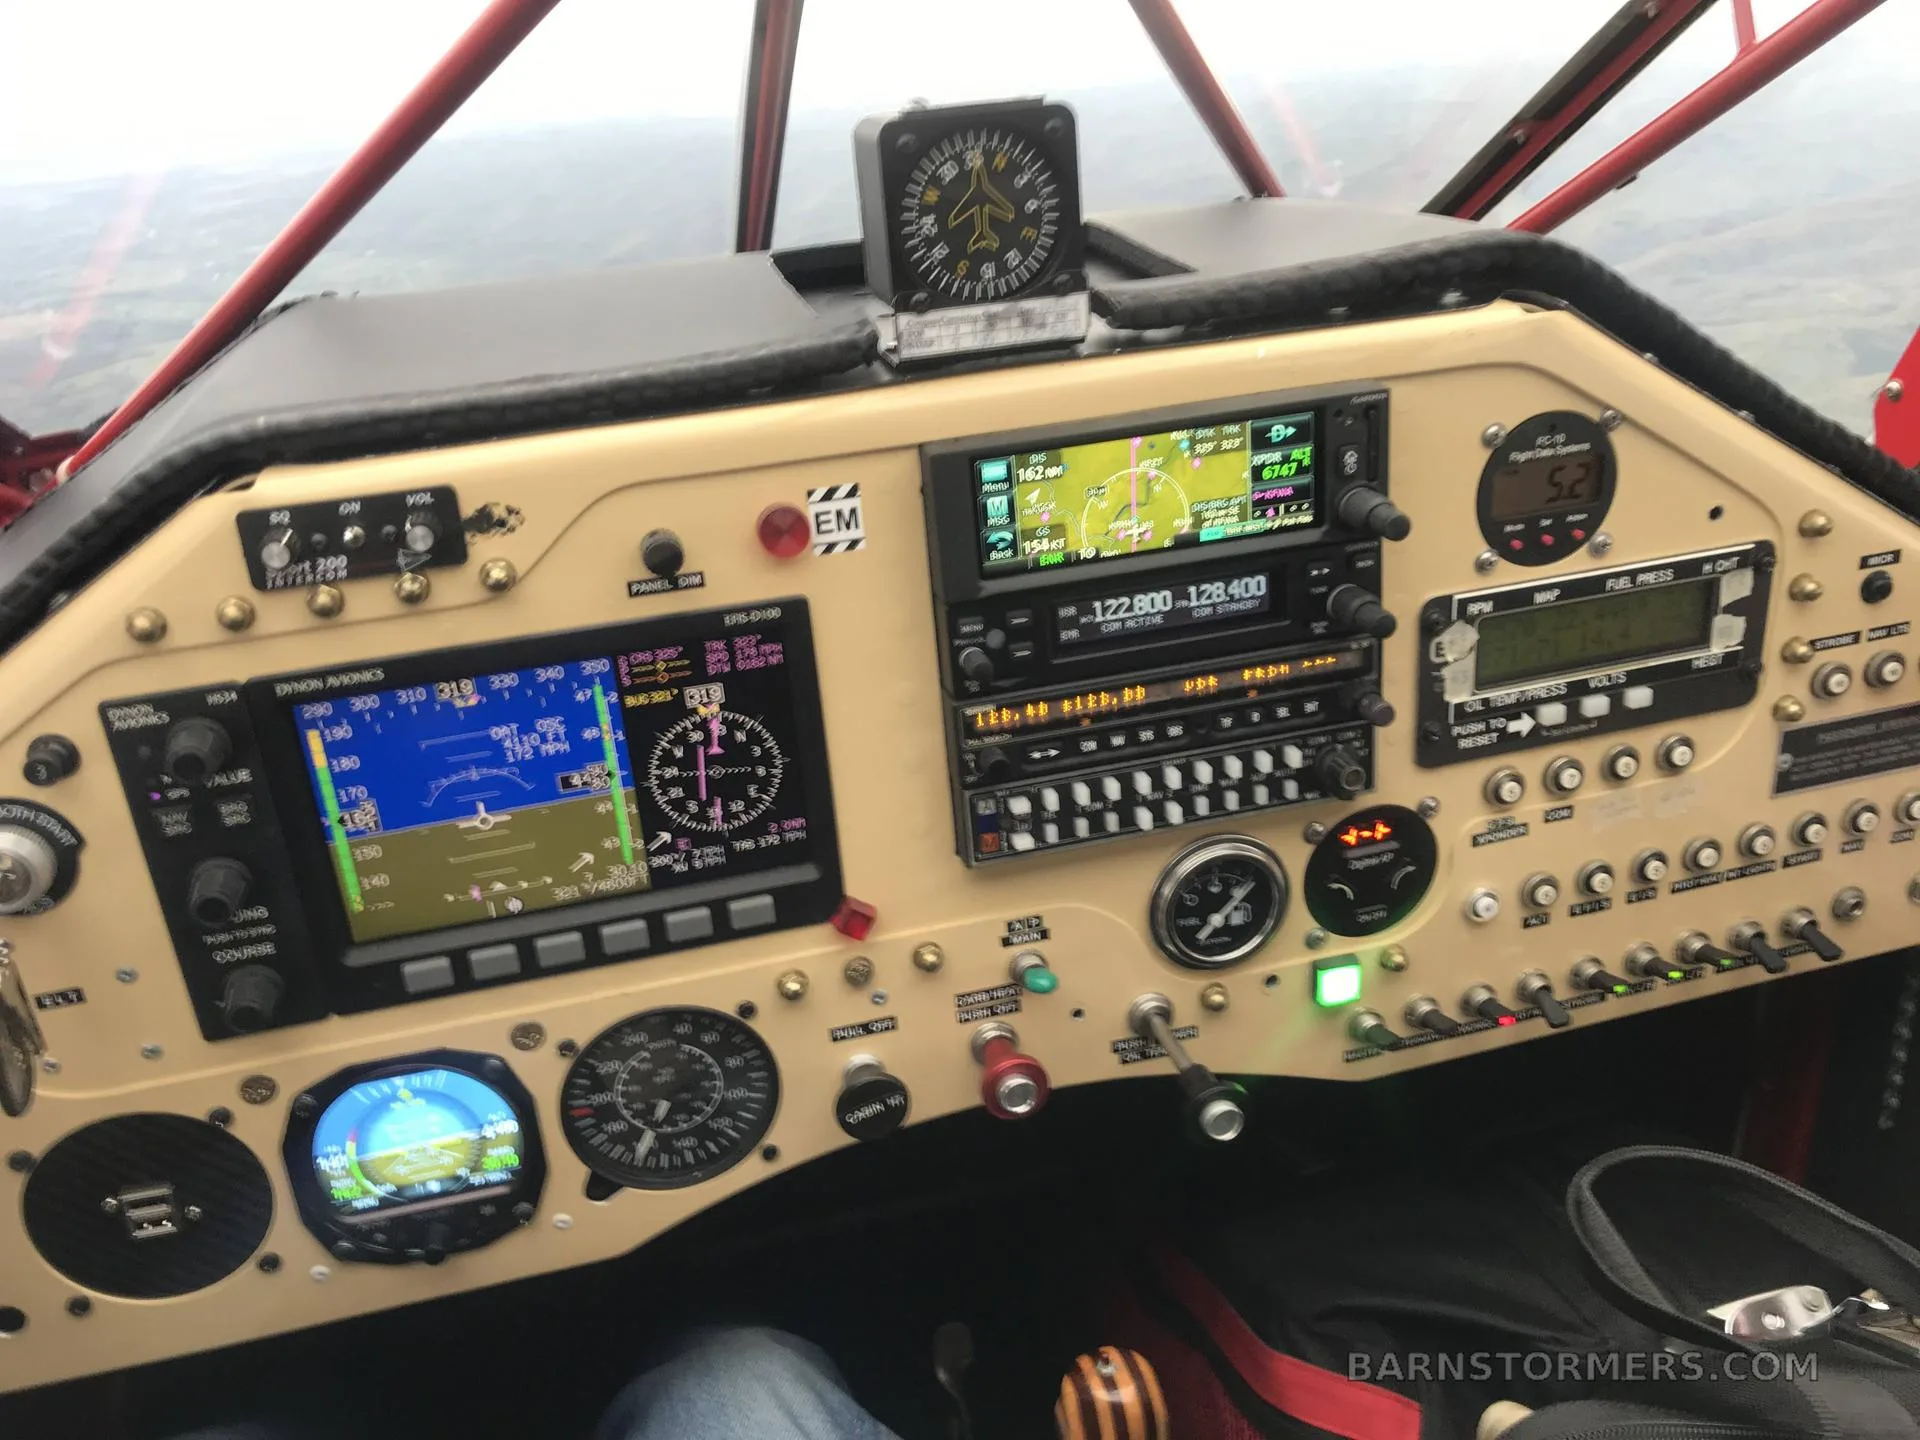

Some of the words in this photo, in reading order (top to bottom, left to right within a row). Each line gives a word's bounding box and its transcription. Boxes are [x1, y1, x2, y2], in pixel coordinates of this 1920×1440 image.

[815, 506, 860, 535] EM
[631, 579, 674, 596] PANEL
[677, 573, 703, 588] DIM
[1187, 574, 1268, 608] 128.400
[1092, 589, 1174, 623] 122.800
[1587, 671, 1628, 689] VOLTS
[1450, 720, 1487, 737] PUSH
[1489, 717, 1508, 731] TO
[1457, 732, 1500, 750] RESET
